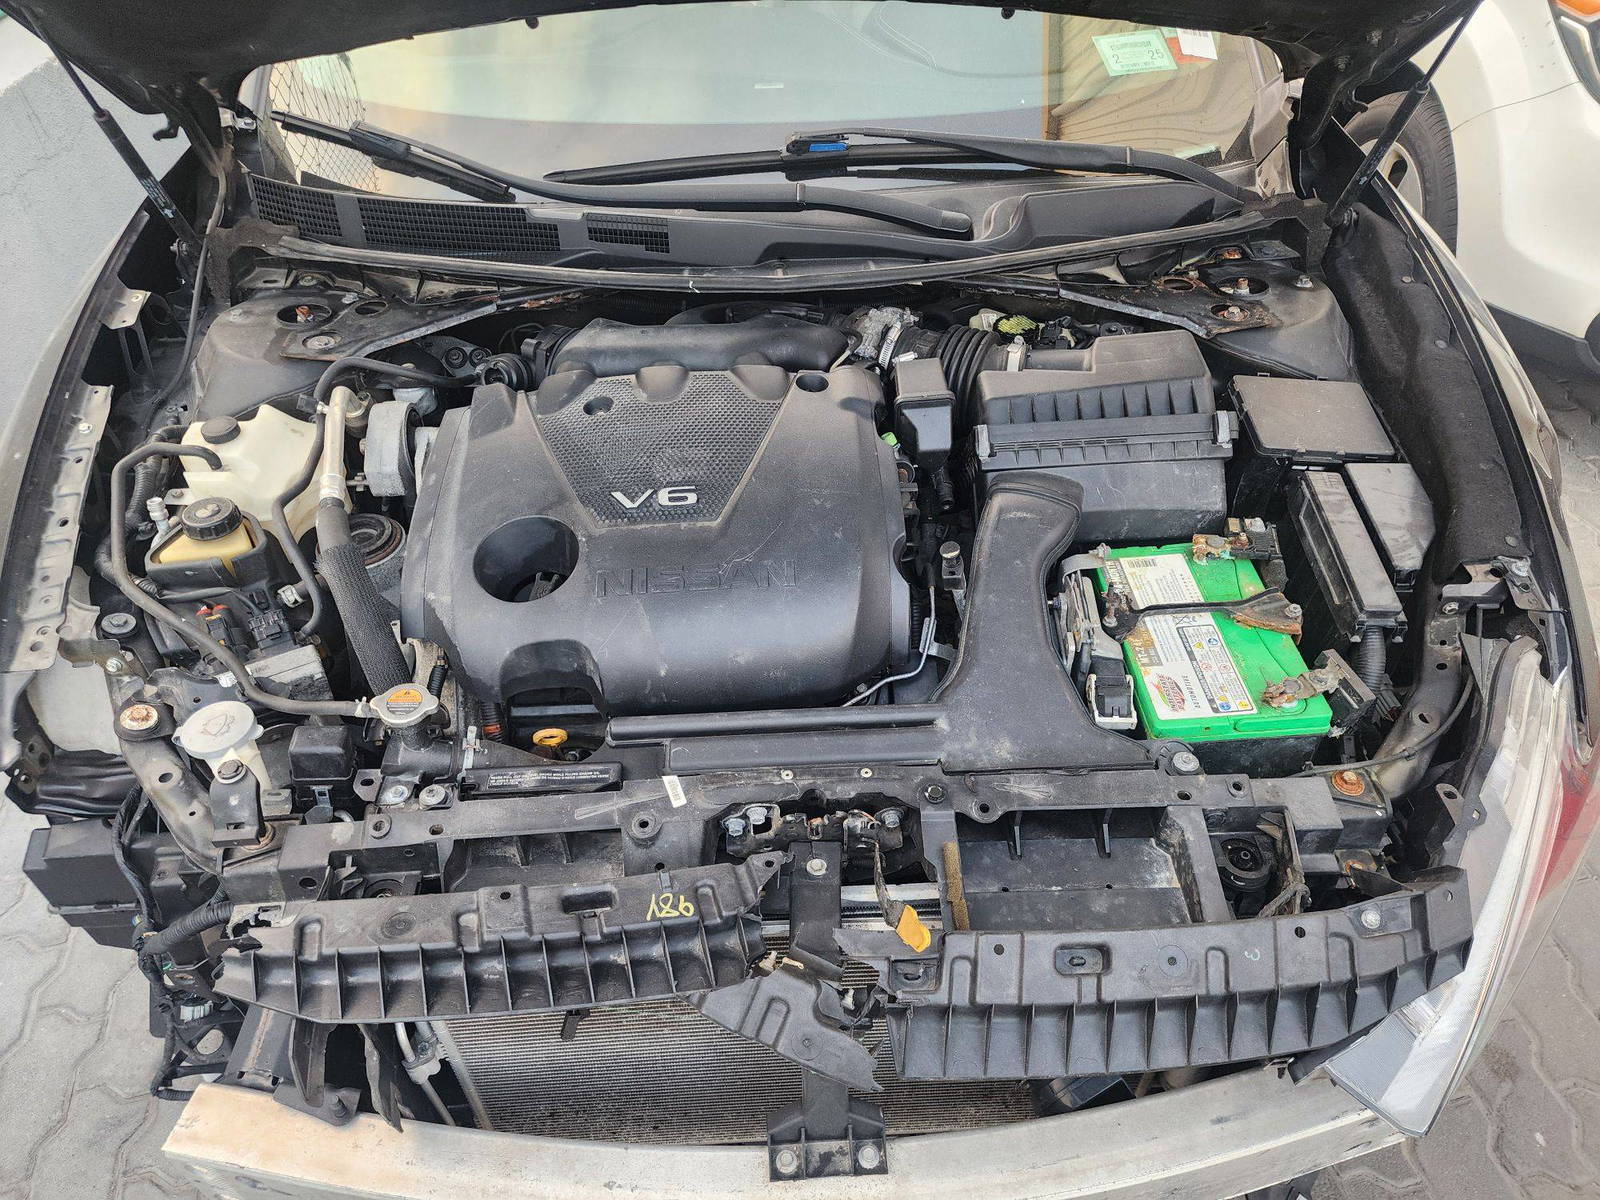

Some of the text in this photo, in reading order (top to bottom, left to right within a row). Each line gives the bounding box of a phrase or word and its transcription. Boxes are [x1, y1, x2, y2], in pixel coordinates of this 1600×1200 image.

[1148, 49, 1165, 60] 25
[610, 485, 698, 510] V6
[595, 559, 797, 599] NISSAN
